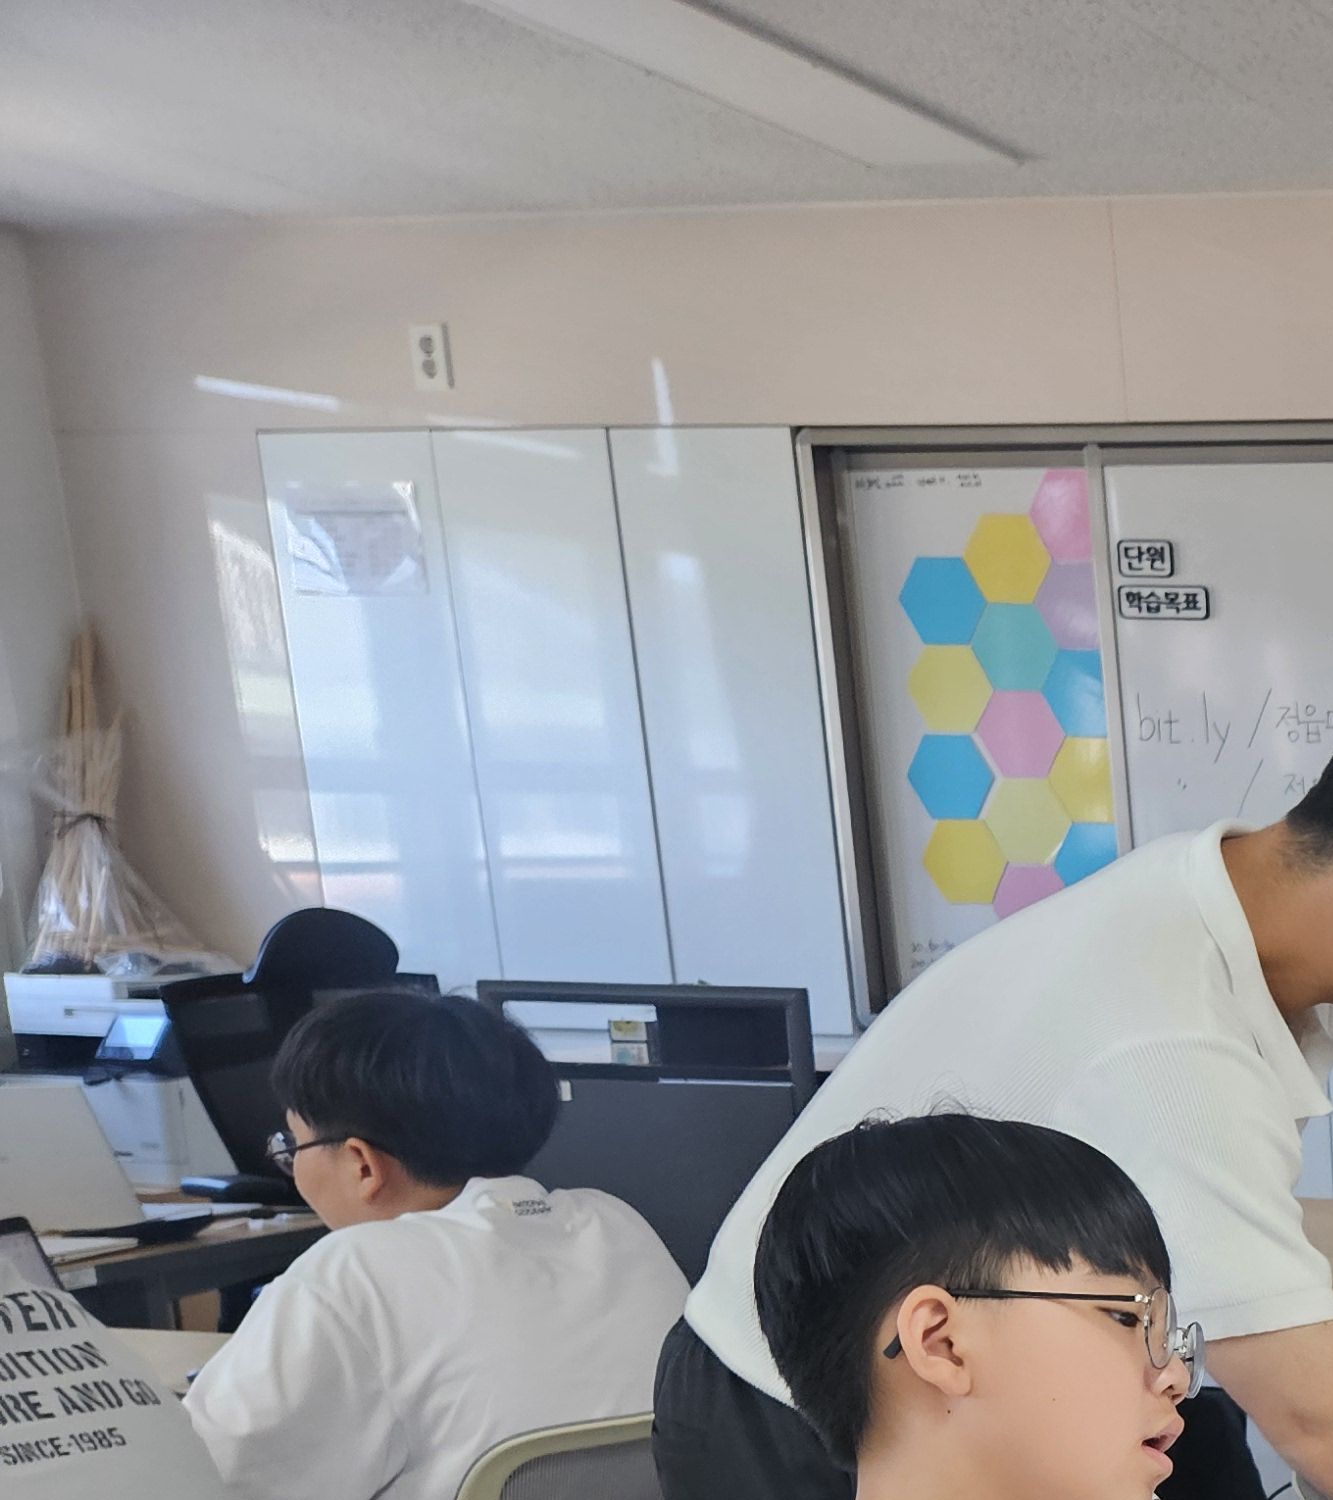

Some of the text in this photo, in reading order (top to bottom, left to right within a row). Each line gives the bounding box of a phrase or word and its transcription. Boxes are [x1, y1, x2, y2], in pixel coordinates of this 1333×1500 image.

[1123, 545, 1167, 572] 단원
[1125, 591, 1202, 614] 학습목표
[54, 1379, 124, 1416] AND
